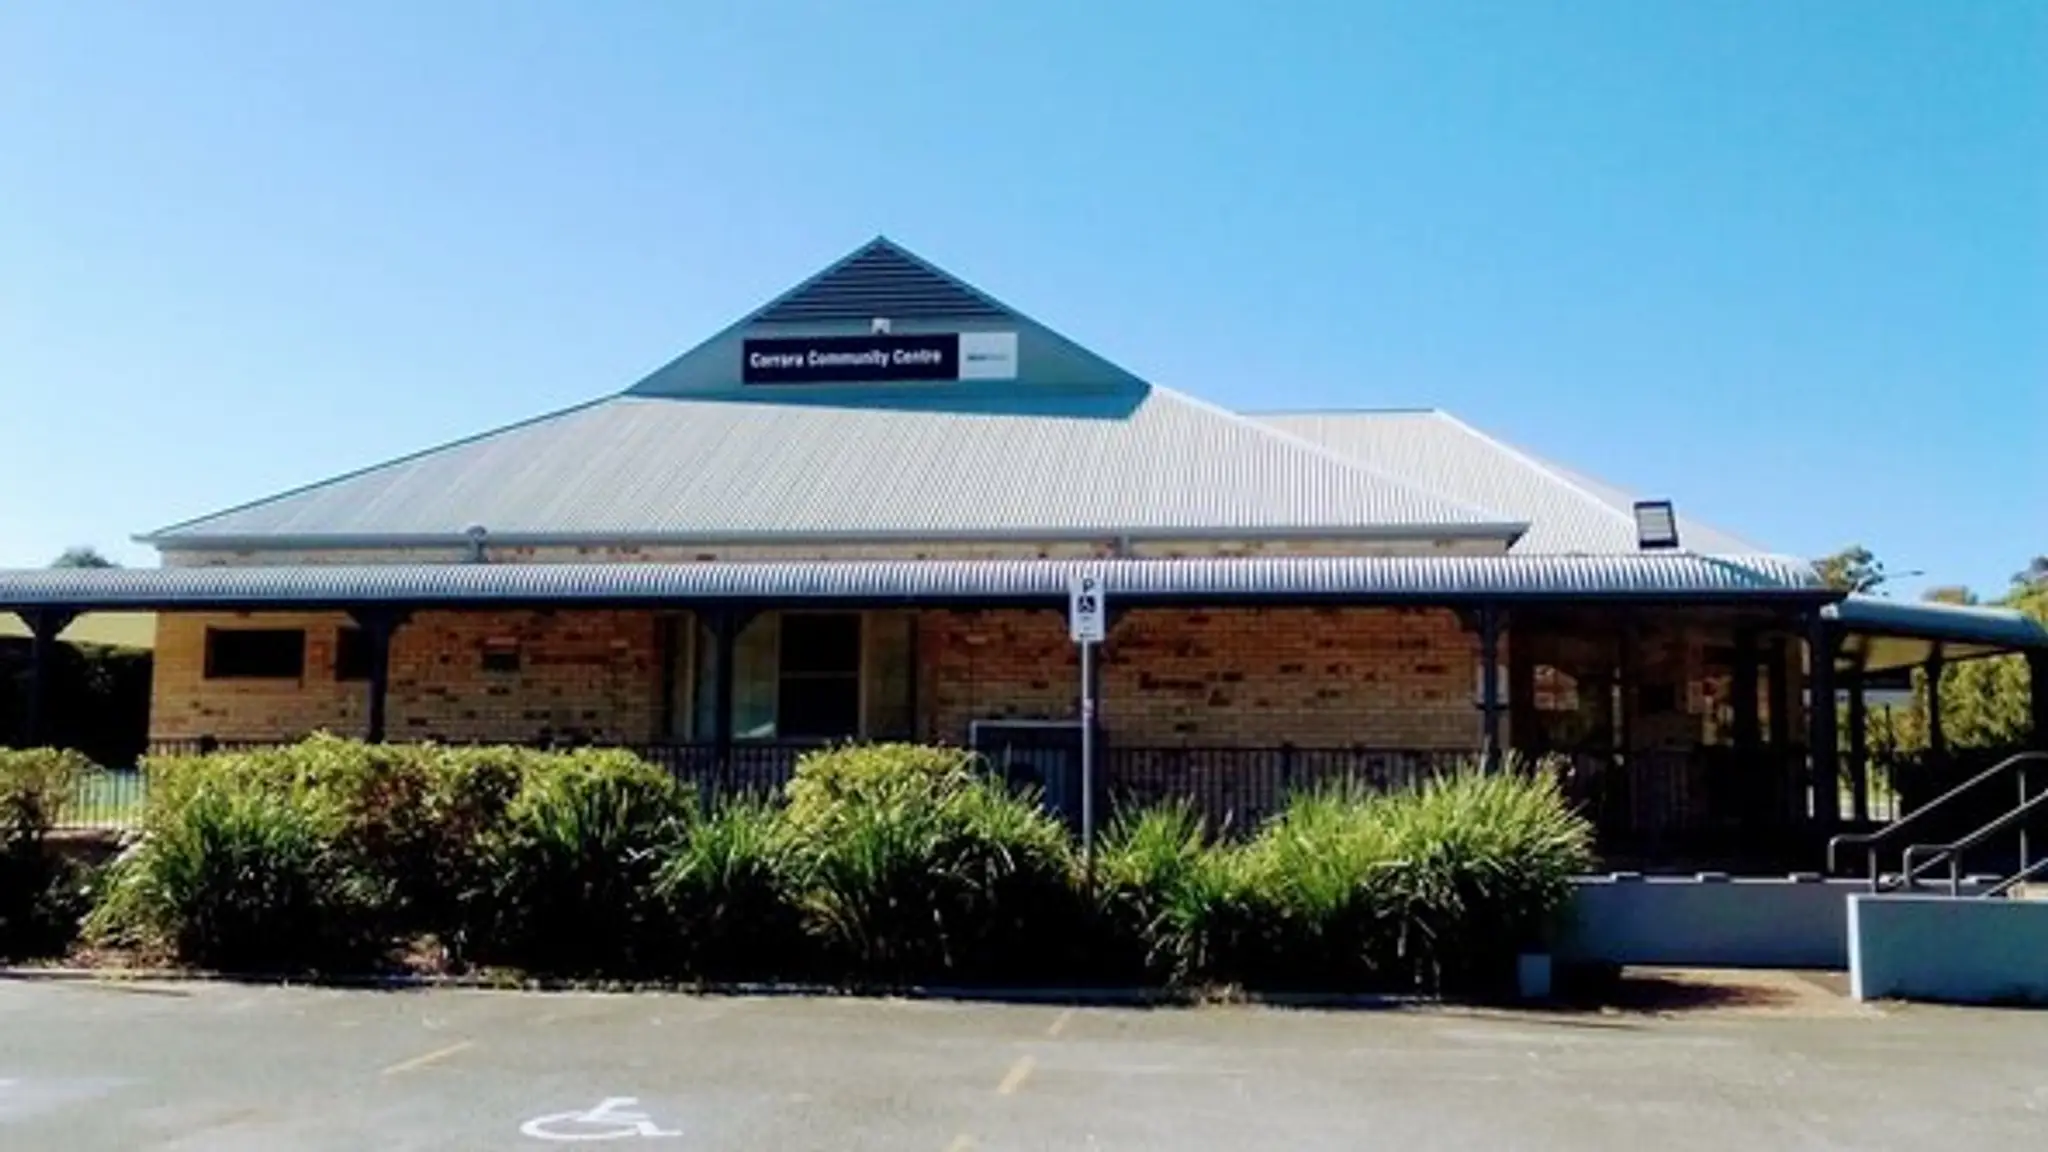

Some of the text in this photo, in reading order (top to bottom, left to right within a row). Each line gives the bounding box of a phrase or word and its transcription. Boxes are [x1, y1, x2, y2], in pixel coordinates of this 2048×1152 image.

[807, 349, 890, 368] Community
[892, 348, 943, 365] Centre
[1082, 578, 1095, 593] P
